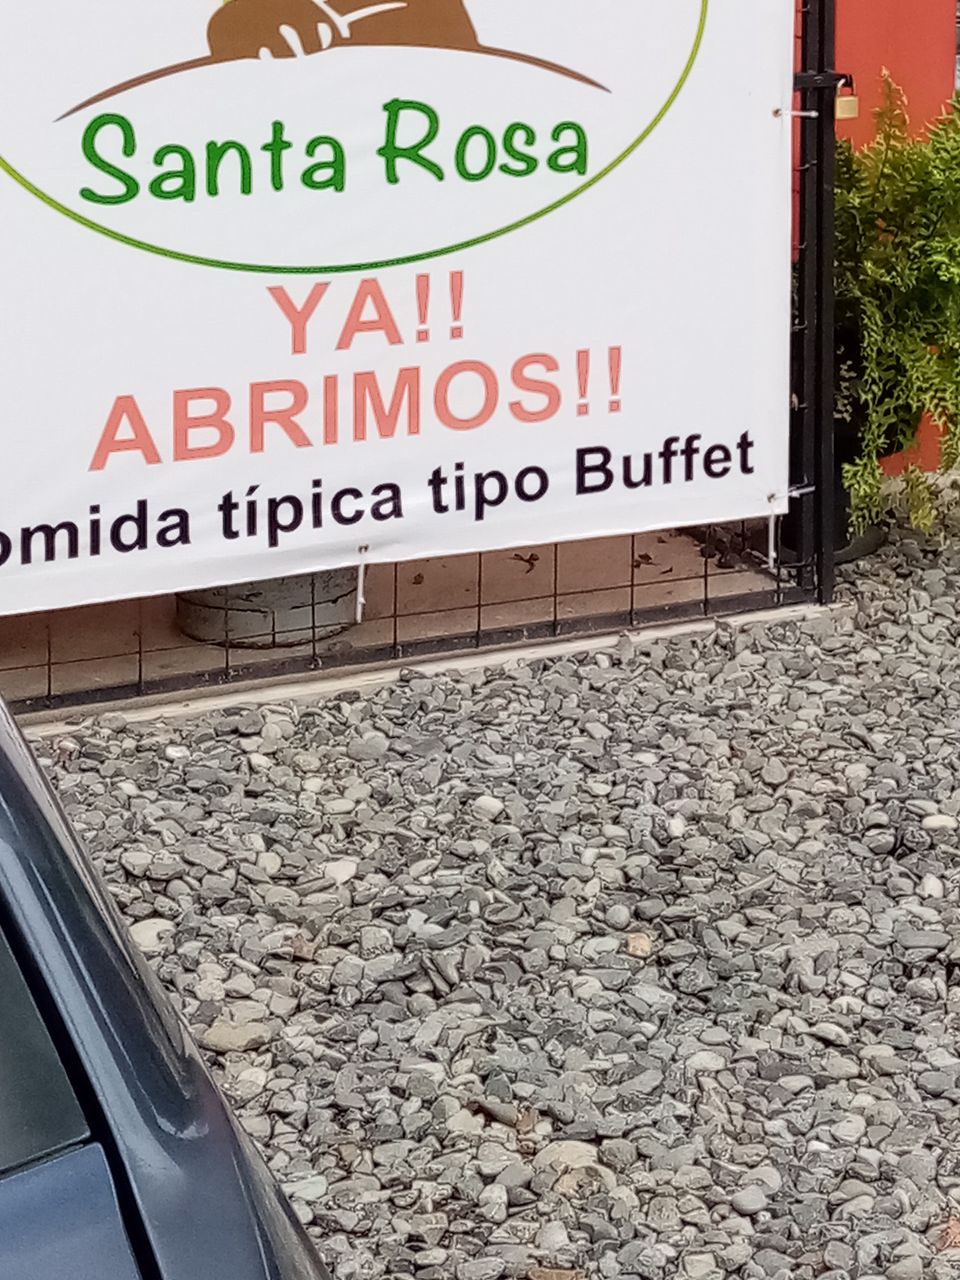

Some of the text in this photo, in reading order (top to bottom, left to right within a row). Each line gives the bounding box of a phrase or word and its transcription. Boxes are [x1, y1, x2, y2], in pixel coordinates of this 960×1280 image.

[79, 98, 589, 206] Santa Rosa
[267, 270, 464, 356] YA!!
[88, 345, 622, 472] ABRIMOS!!
[217, 479, 403, 548] típica
[427, 462, 549, 521] tipo
[576, 431, 754, 495] Buffet
